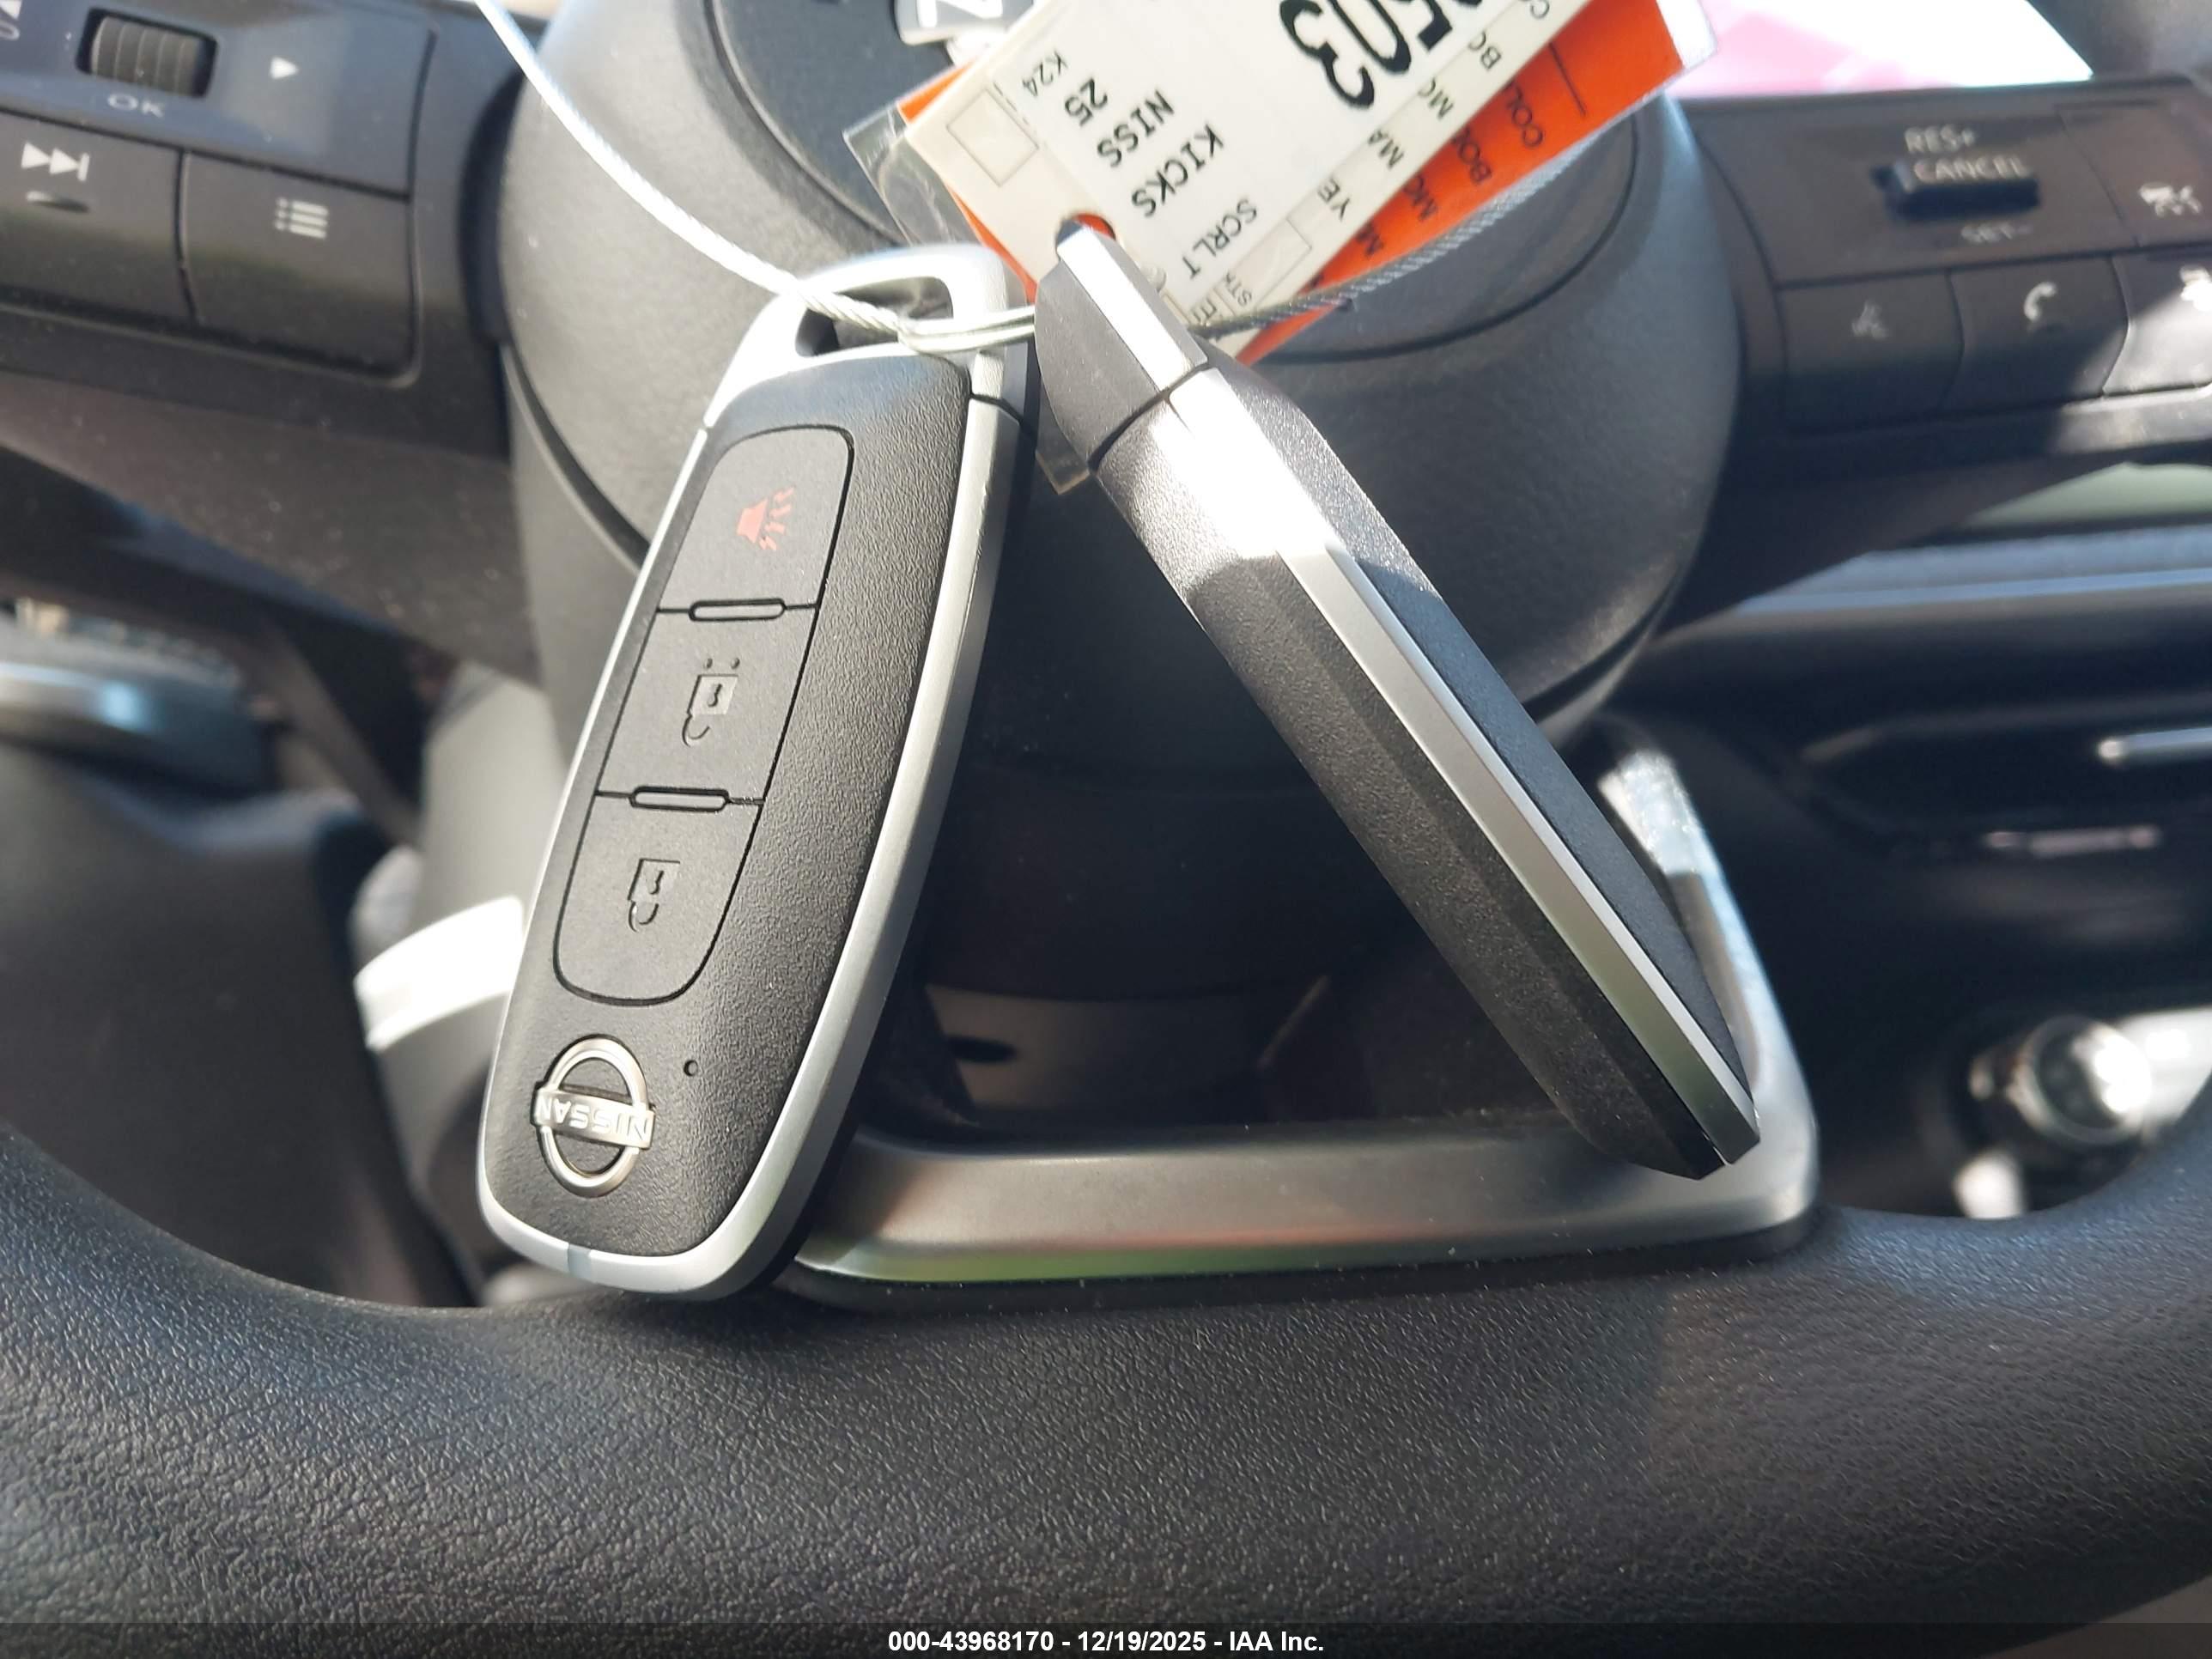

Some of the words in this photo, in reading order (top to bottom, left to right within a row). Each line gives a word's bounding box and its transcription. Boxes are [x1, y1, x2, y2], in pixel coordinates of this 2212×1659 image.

[1022, 51, 1069, 97] K24
[1279, 0, 1483, 109] 503
[107, 93, 165, 118] OK
[1064, 77, 1109, 126] 25
[1097, 88, 1175, 168] NISS
[1504, 81, 1544, 149] COL
[1131, 123, 1224, 218] KICKS
[1913, 155, 2032, 183] CANCEL
[1182, 198, 1258, 280] SCRLT
[535, 1093, 649, 1144] NISSAN
